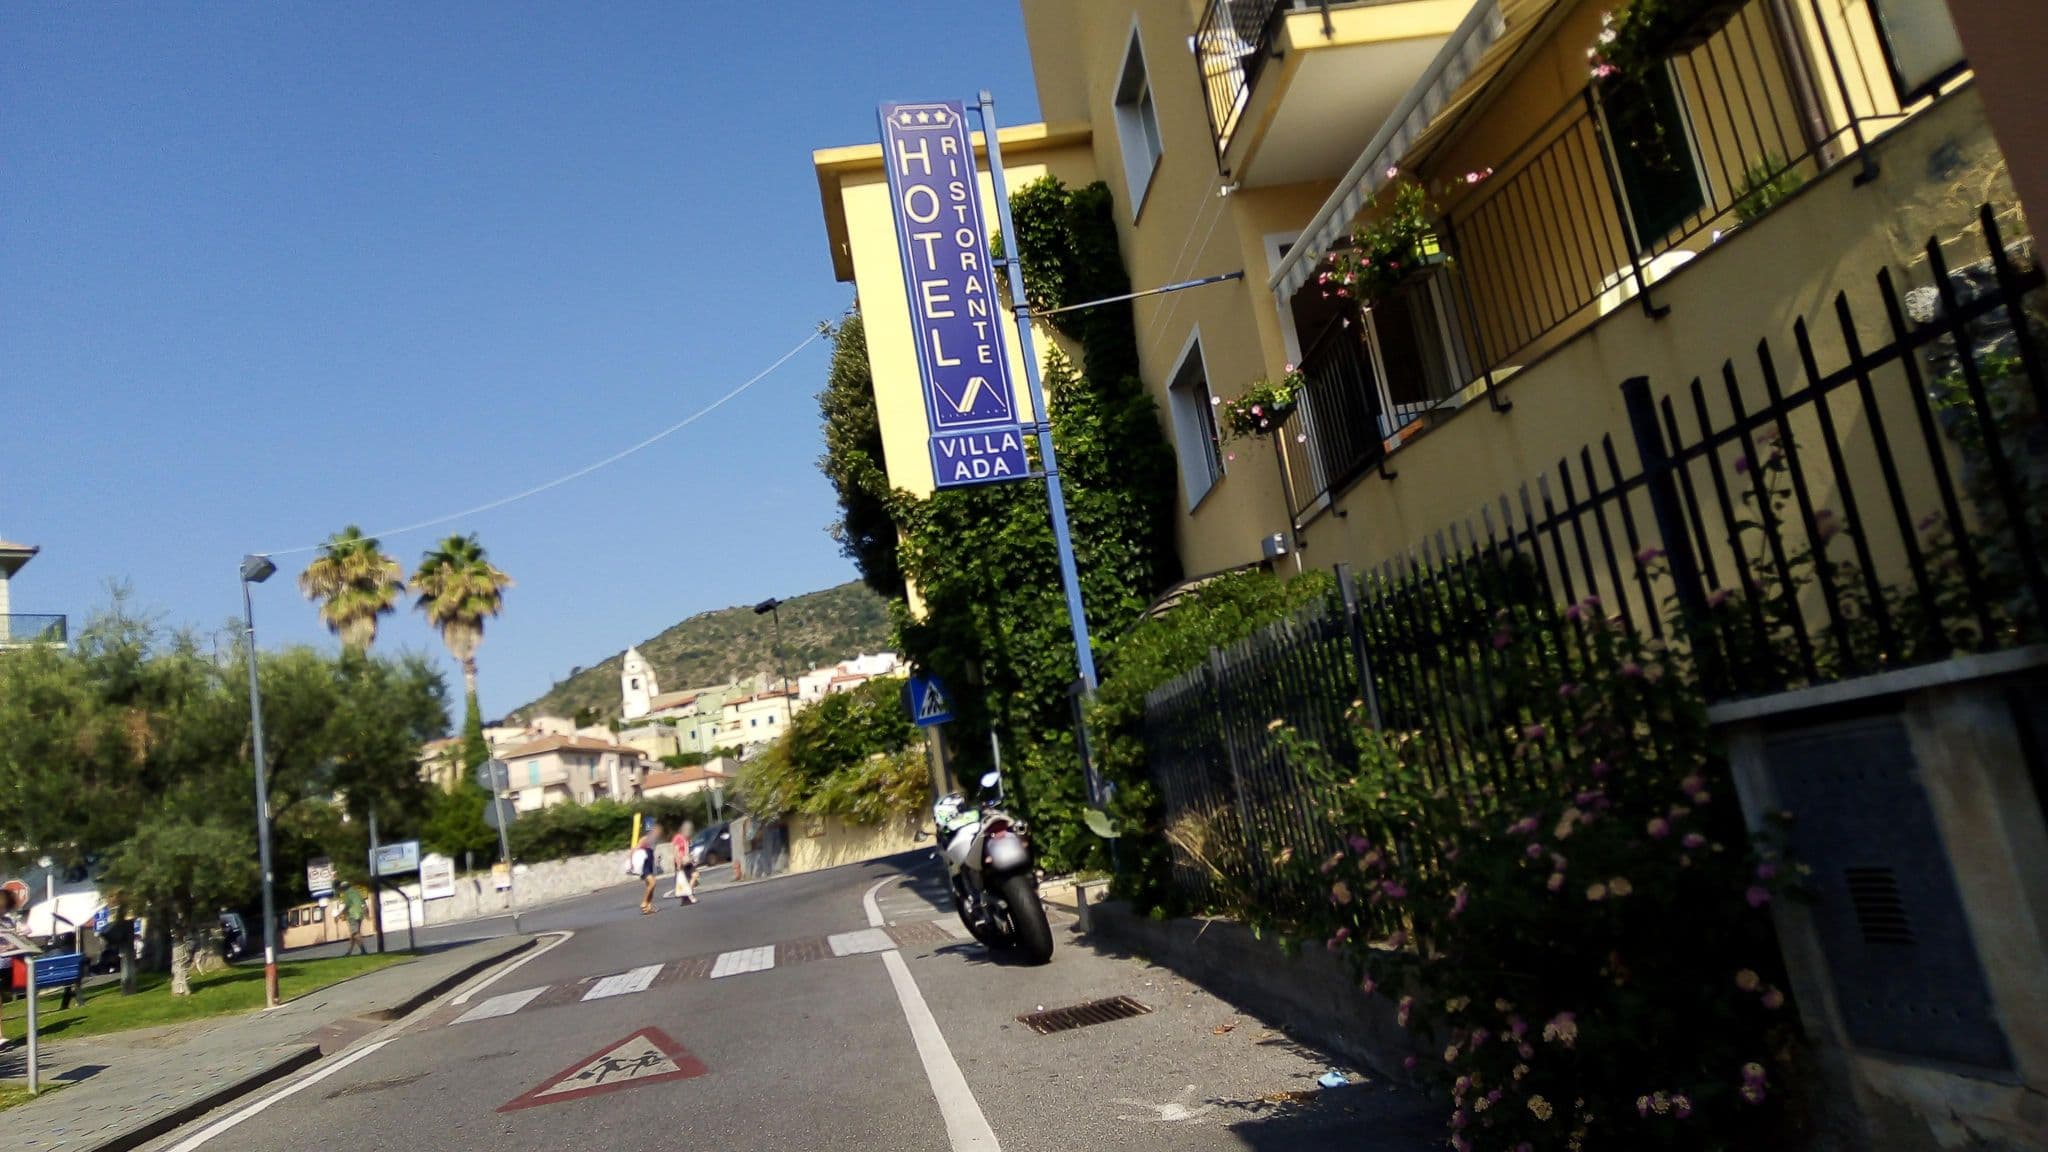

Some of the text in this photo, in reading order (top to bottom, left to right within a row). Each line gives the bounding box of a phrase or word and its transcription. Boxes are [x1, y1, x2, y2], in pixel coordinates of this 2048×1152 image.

[898, 137, 961, 367] HOTEL
[940, 136, 993, 364] RISTORANTE
[939, 432, 1018, 458] VILLA
[955, 457, 1011, 480] ADA
